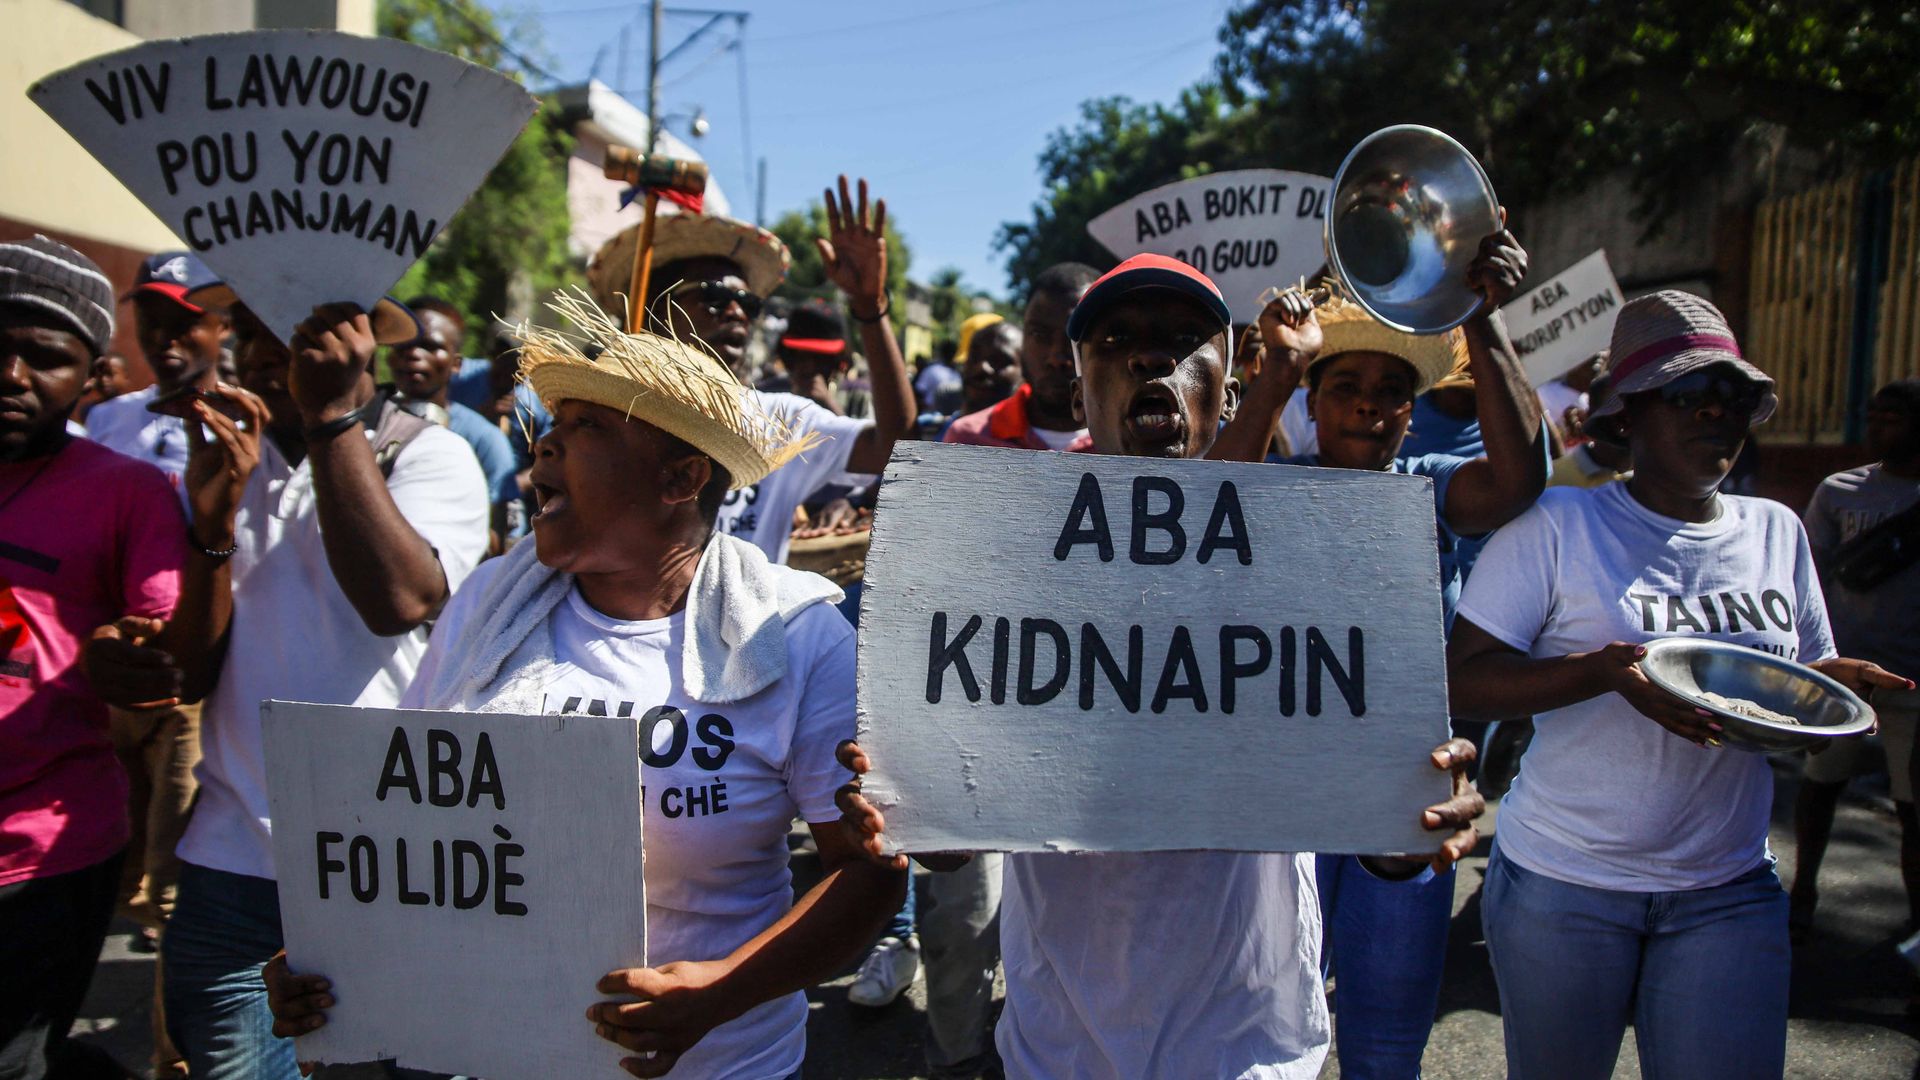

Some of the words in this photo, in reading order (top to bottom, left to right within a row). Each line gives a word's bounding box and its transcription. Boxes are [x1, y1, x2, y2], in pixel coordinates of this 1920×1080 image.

[85, 62, 170, 125] VIV
[206, 53, 430, 128] LAWOUSI
[156, 131, 258, 195] POU
[282, 130, 391, 185] YON
[182, 189, 437, 259] CHANJMAN
[1134, 197, 1192, 244] ABA
[1204, 184, 1288, 221] BOKIT
[1212, 239, 1278, 273] GOUD
[1530, 280, 1569, 316] ABA
[1053, 472, 1253, 566] ABA
[1629, 588, 1793, 634] TAINO
[926, 611, 1366, 717] KIDNAPIN
[376, 726, 506, 810] ABA
[660, 776, 729, 819] CHÈ
[316, 831, 379, 904] FO
[396, 824, 529, 916] LIDÈ
